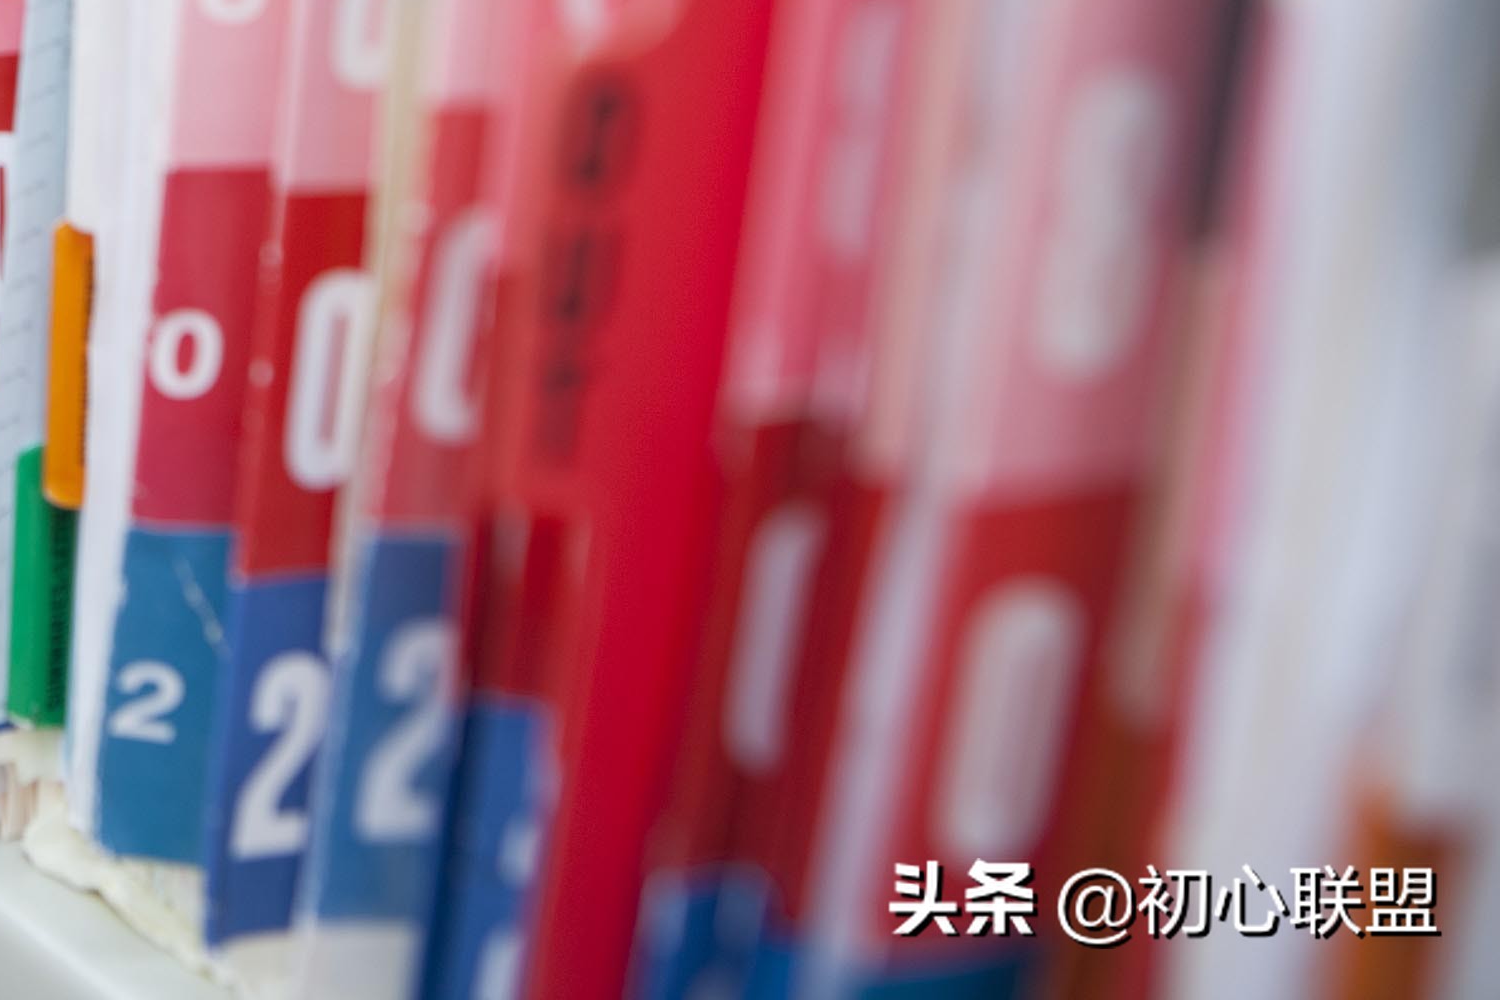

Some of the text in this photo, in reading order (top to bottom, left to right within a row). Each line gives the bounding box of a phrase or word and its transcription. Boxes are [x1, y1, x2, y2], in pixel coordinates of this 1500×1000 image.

[148, 308, 224, 400] 0
[284, 266, 376, 490] 0
[108, 660, 185, 743] 2
[230, 648, 333, 861] 2
[352, 618, 460, 843] 2
